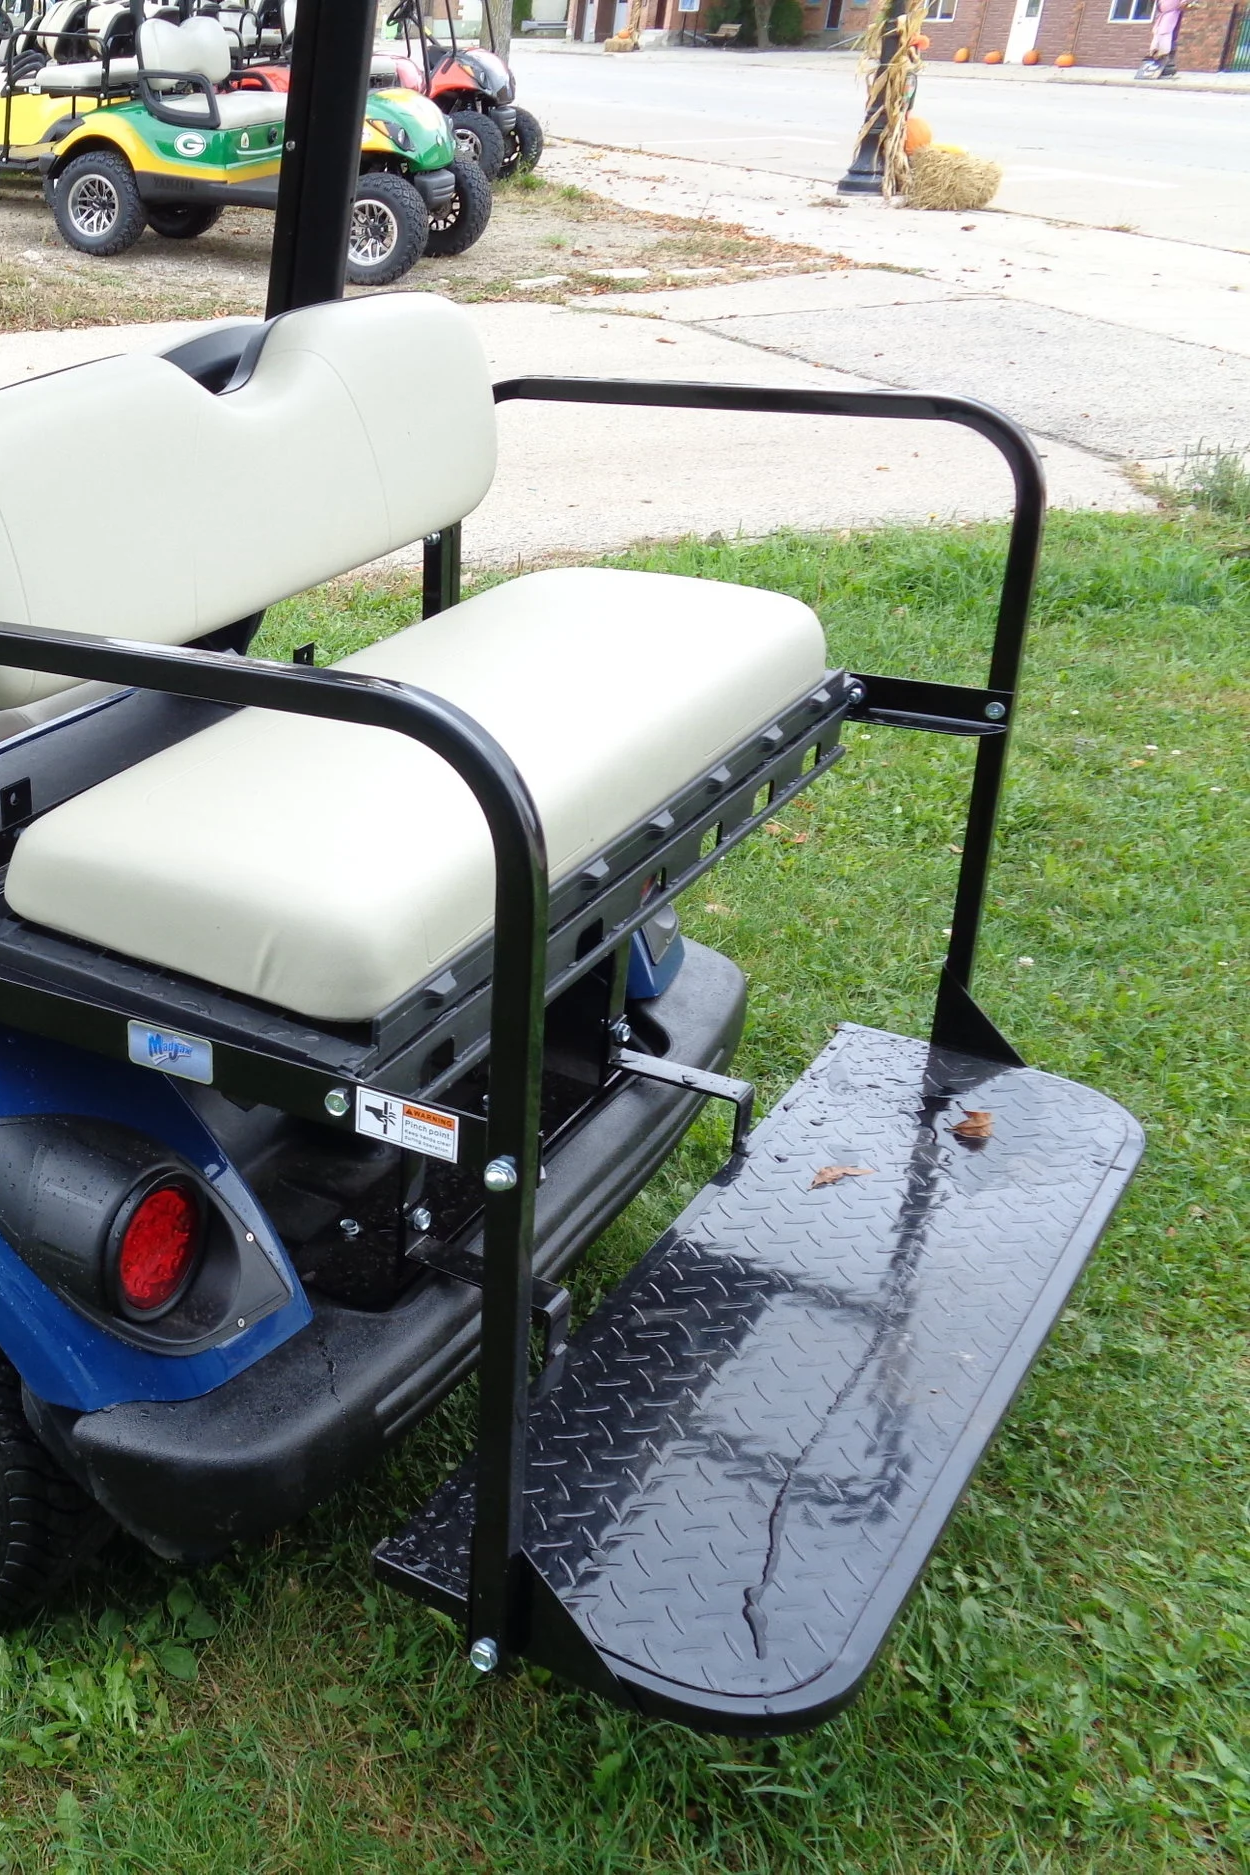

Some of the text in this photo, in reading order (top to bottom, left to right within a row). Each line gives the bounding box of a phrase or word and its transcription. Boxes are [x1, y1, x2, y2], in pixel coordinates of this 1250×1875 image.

[174, 132, 206, 157] G
[405, 1120, 427, 1132] Pinch
[413, 1111, 452, 1127] WARNING
